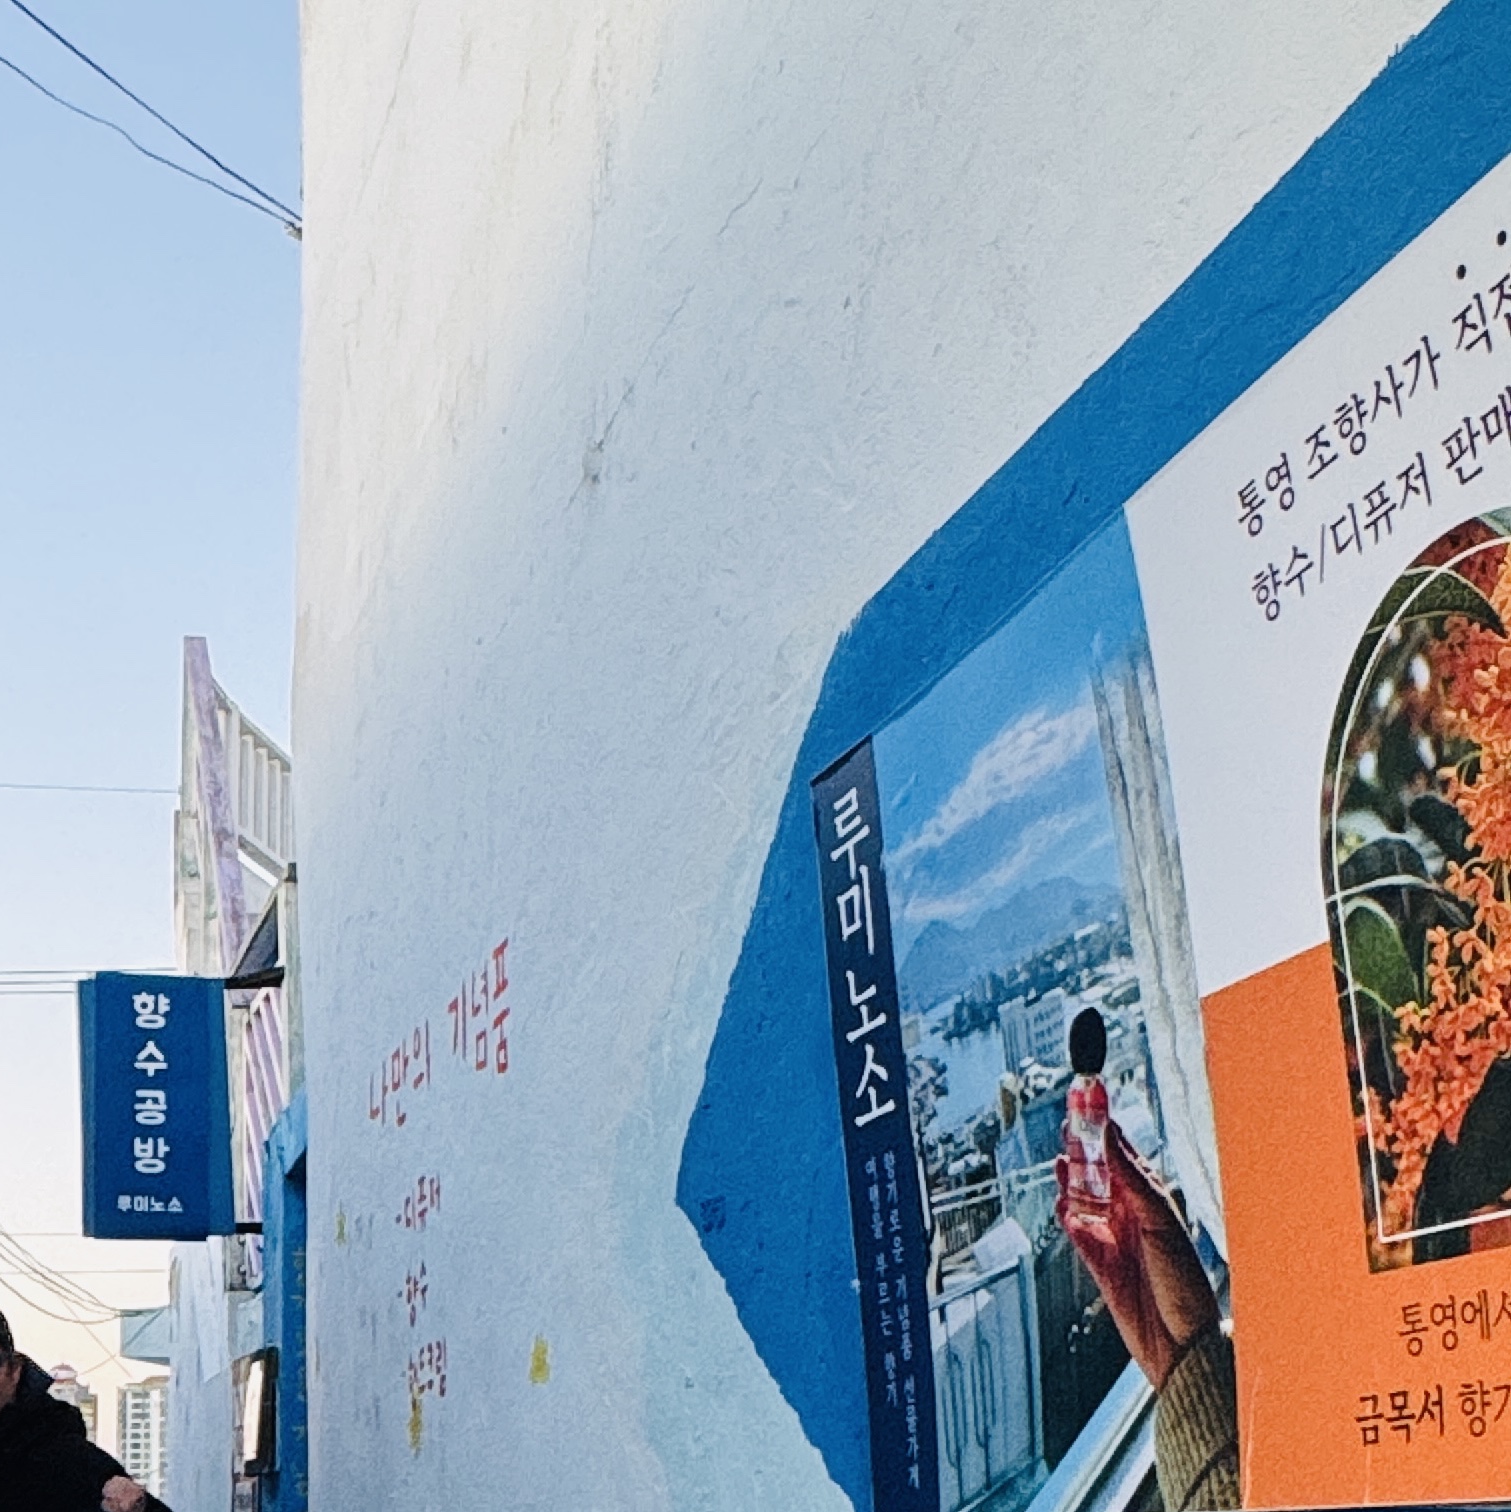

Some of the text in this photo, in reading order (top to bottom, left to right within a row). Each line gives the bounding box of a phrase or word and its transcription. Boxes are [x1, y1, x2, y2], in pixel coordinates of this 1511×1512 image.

[1236, 451, 1296, 538] 통영
[1303, 335, 1441, 480] 조향사가
[1251, 450, 1432, 622] 향수/디퓨저
[369, 936, 511, 1127] 나만의 기념품
[830, 786, 895, 1128] 루미노소
[131, 991, 171, 1174] 향수공방
[117, 1194, 183, 1212] 루미노스
[1354, 1382, 1445, 1448] 금목서
